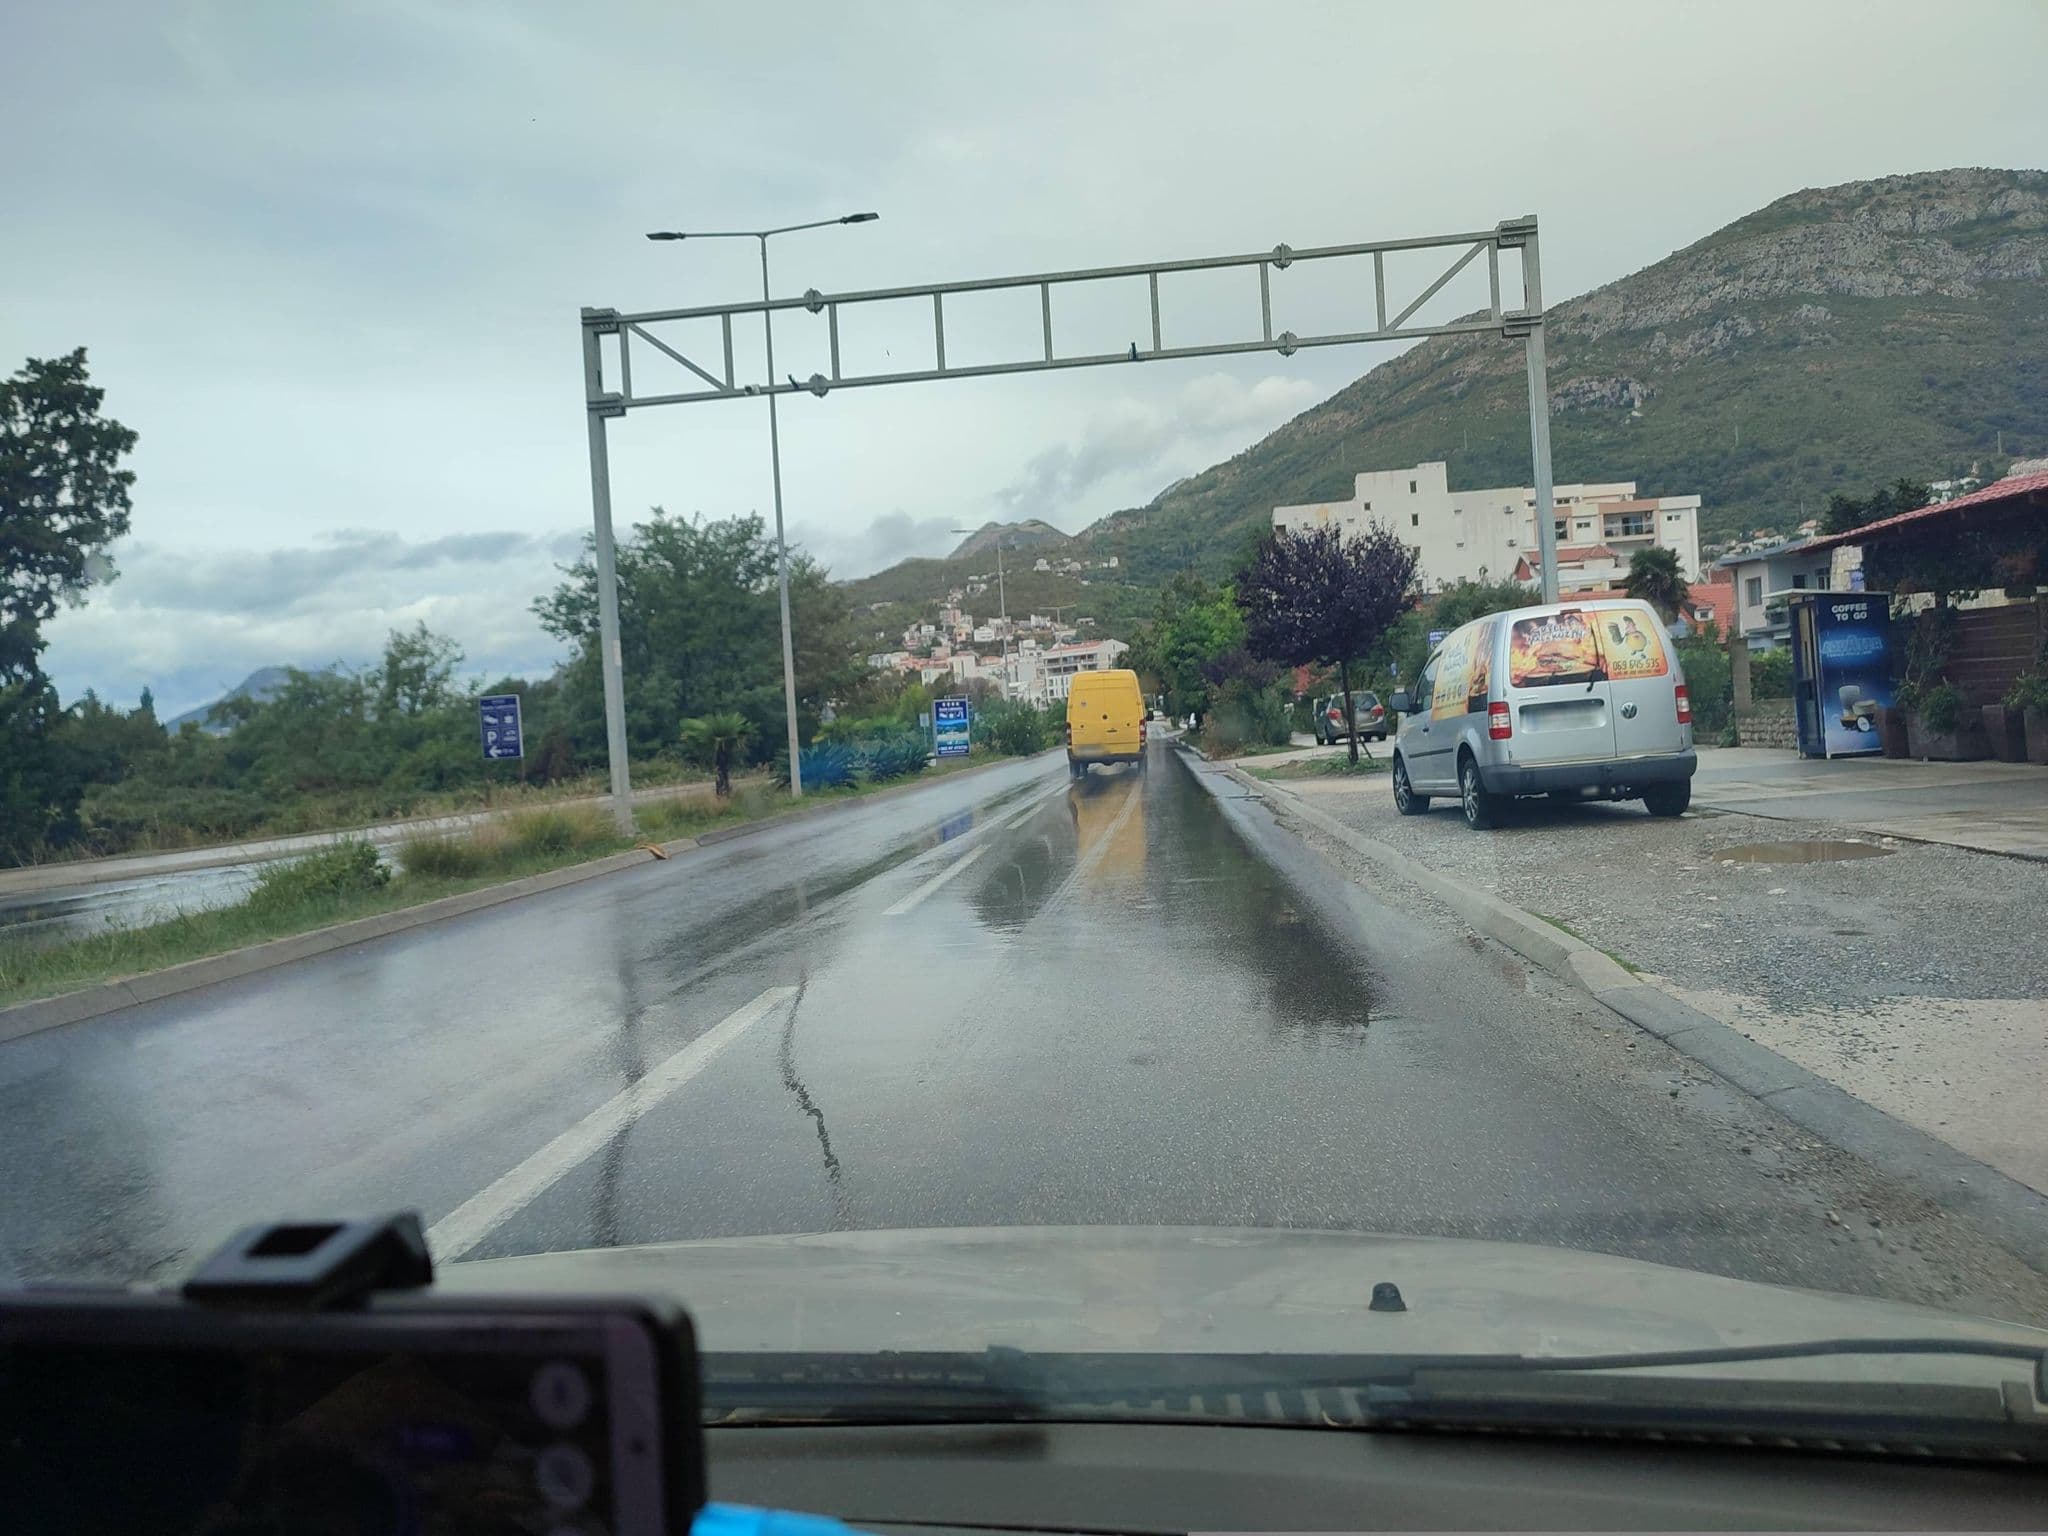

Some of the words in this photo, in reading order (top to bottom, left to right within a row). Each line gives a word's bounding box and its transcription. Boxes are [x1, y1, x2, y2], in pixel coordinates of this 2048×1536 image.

[1831, 603, 1867, 613] COFFEE
[1835, 613, 1848, 621] TO
[1853, 612, 1867, 620] GO
